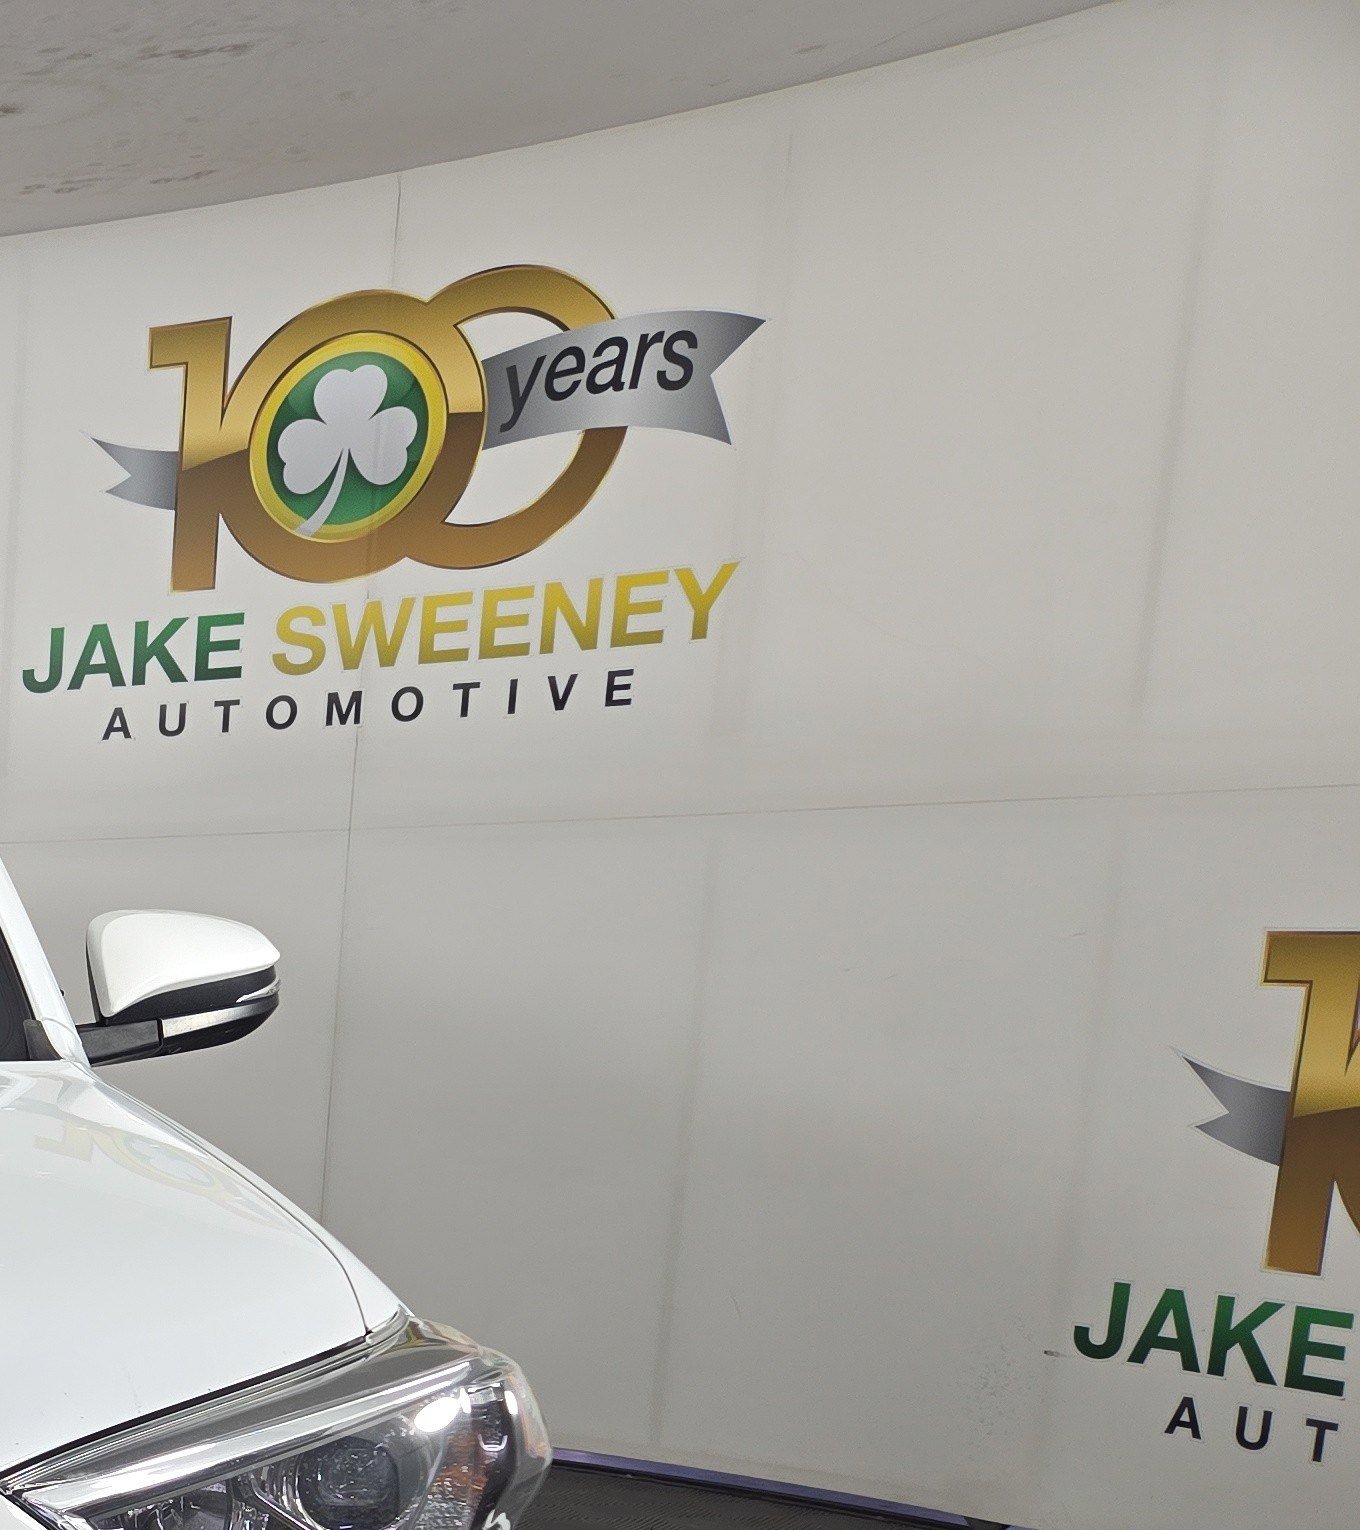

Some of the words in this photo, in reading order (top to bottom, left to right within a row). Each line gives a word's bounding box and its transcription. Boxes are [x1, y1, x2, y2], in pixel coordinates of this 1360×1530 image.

[499, 328, 699, 432] years
[21, 612, 246, 693] JAKE
[271, 561, 740, 676] SWEENEY
[101, 668, 636, 741] AUTOMOTIVE
[1073, 1281, 1354, 1397] JAKE
[1164, 1396, 1340, 1463] AUT
